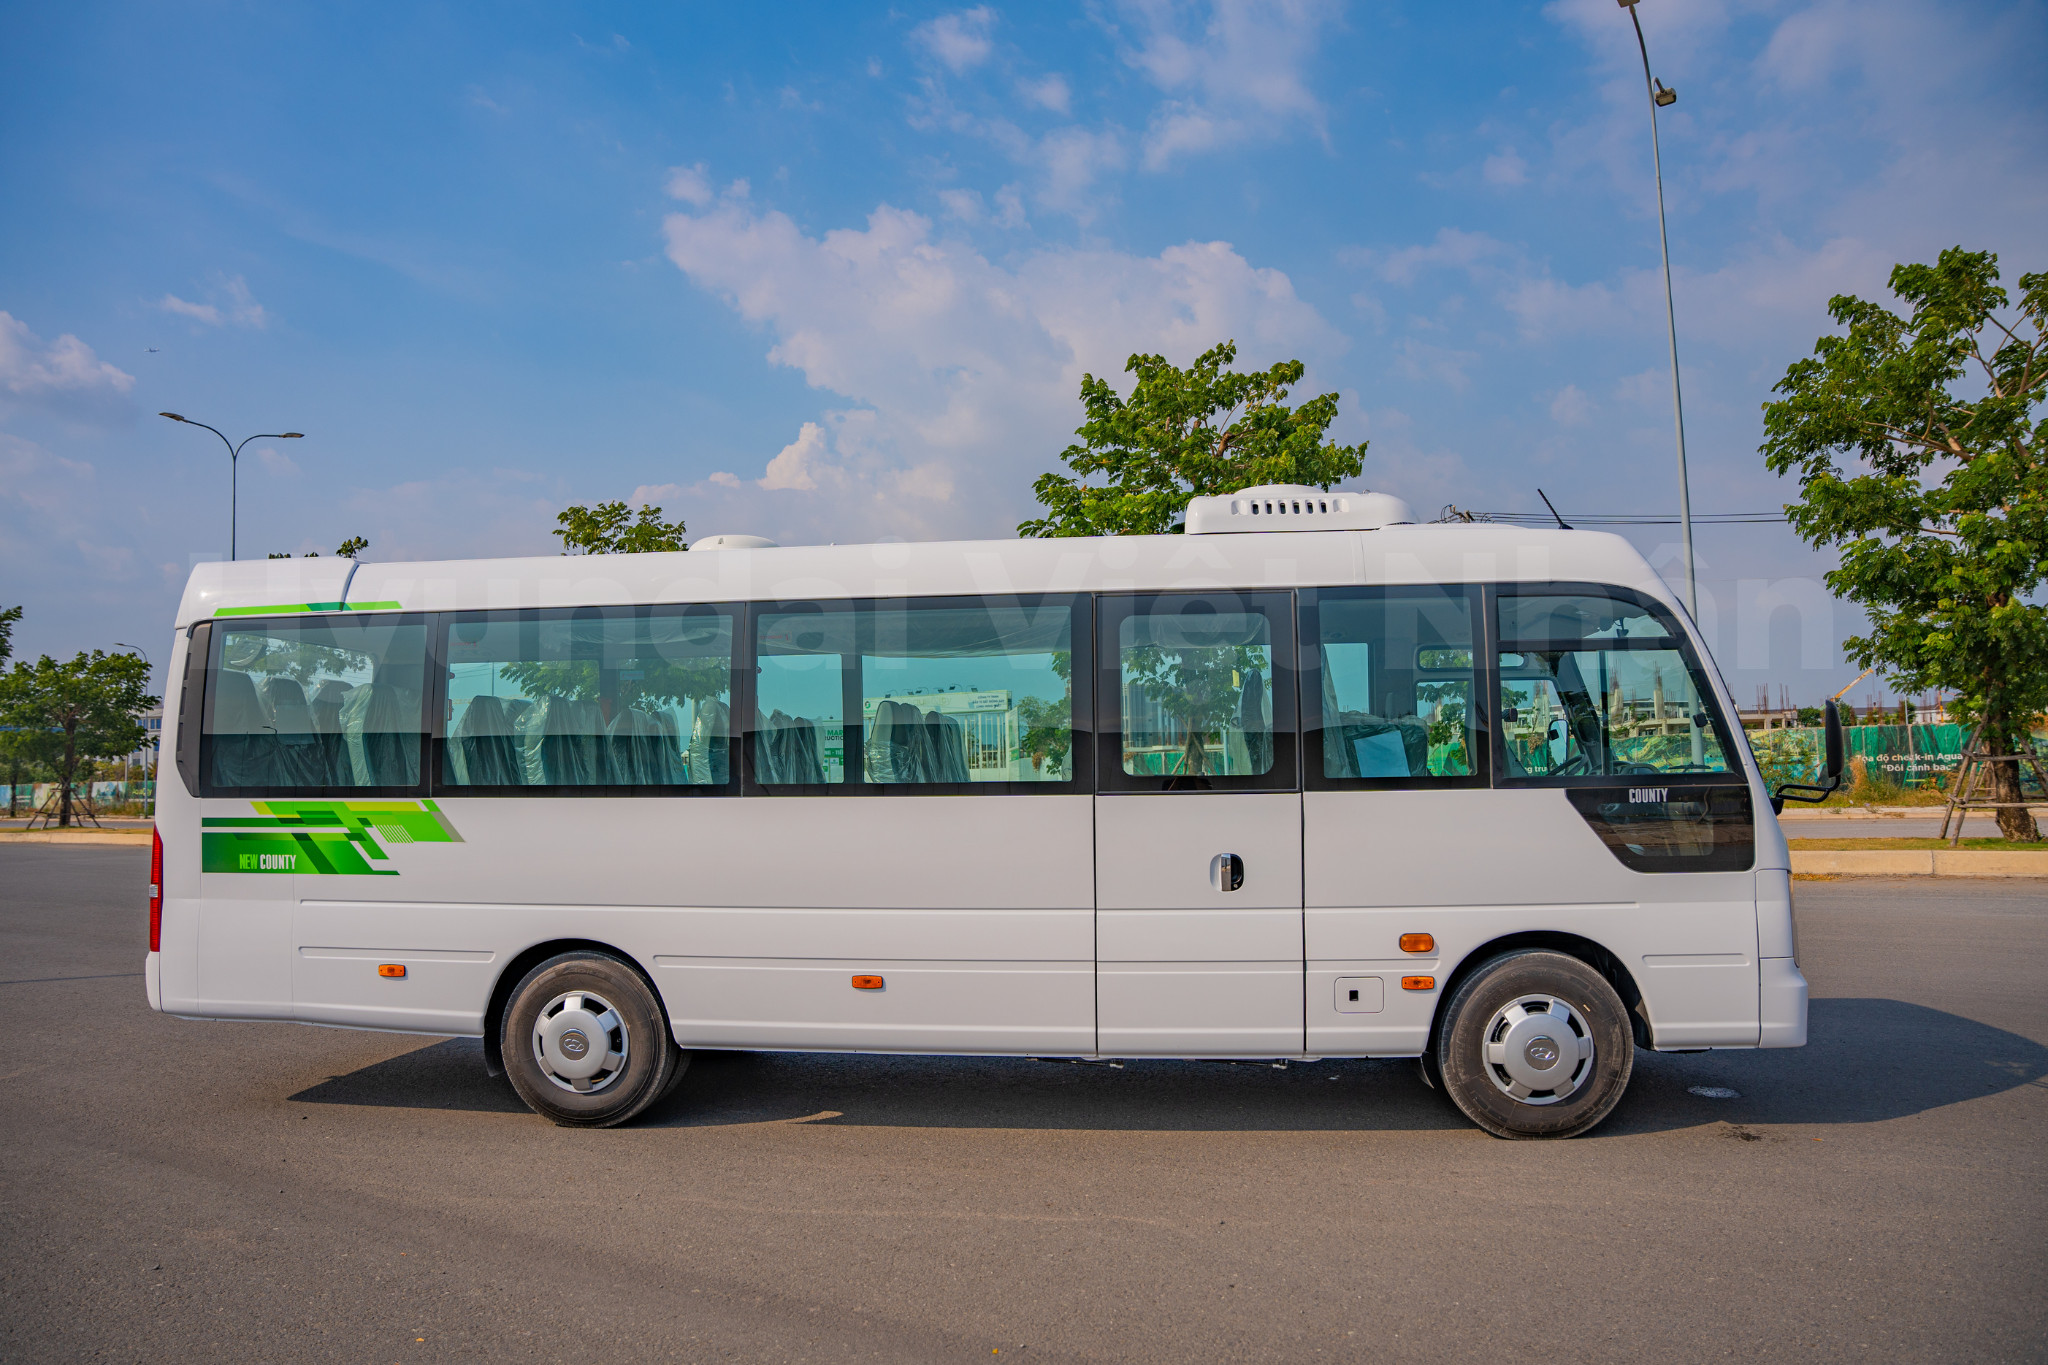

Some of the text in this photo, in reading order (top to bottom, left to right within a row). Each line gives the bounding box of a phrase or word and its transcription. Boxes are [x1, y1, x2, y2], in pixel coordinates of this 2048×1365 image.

[1629, 788, 1668, 803] COUNTY
[239, 854, 296, 870] NEW COUNTY
